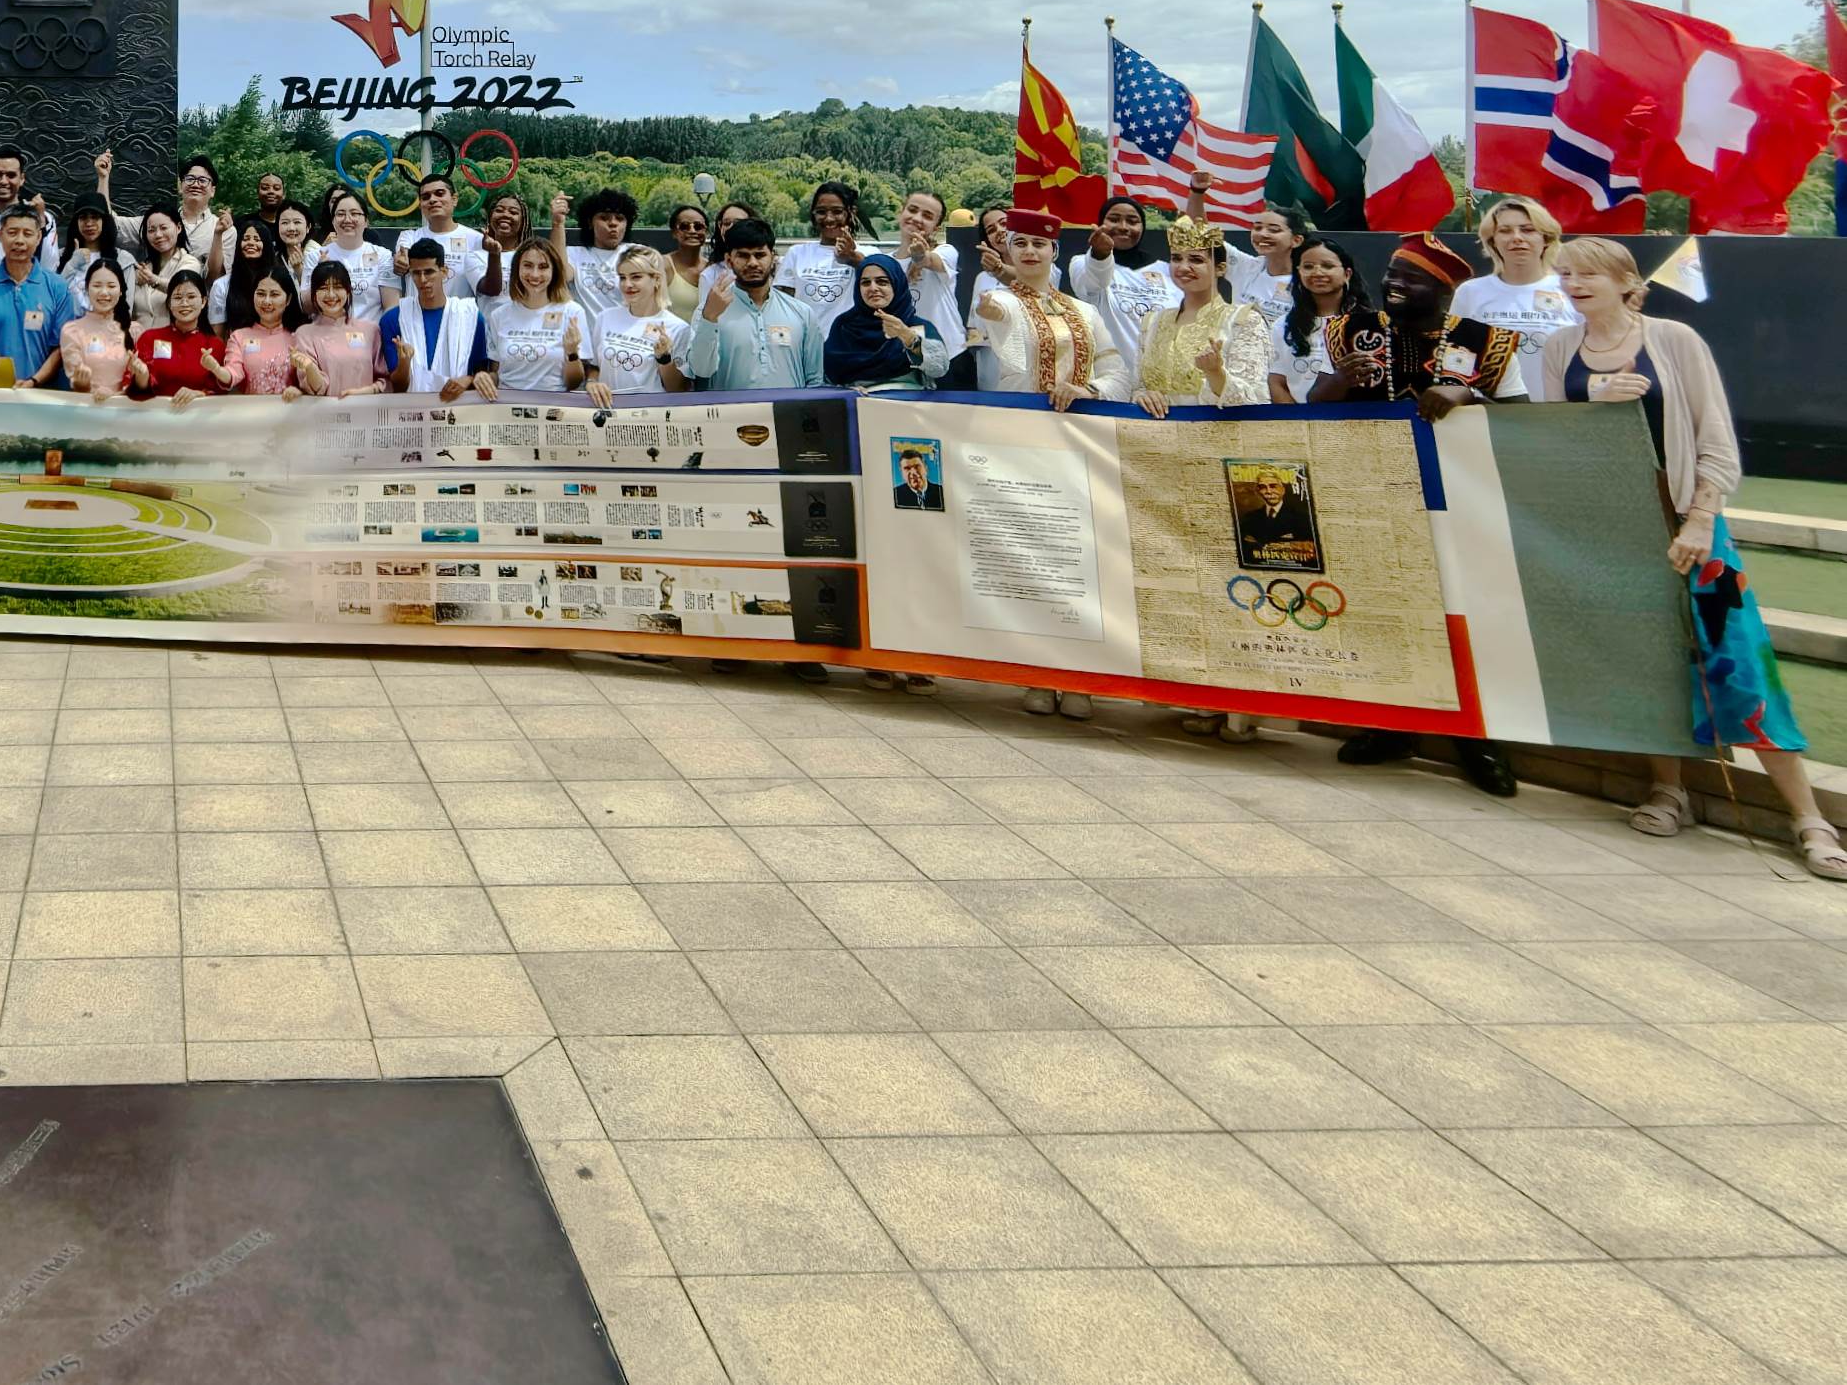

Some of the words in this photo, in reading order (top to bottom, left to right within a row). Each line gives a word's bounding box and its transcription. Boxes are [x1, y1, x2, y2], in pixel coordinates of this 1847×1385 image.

[432, 26, 510, 46] Olympic
[433, 50, 484, 67] Torch
[488, 50, 536, 70] Relay
[280, 76, 437, 122] BEIJING
[452, 75, 575, 112] 2022
